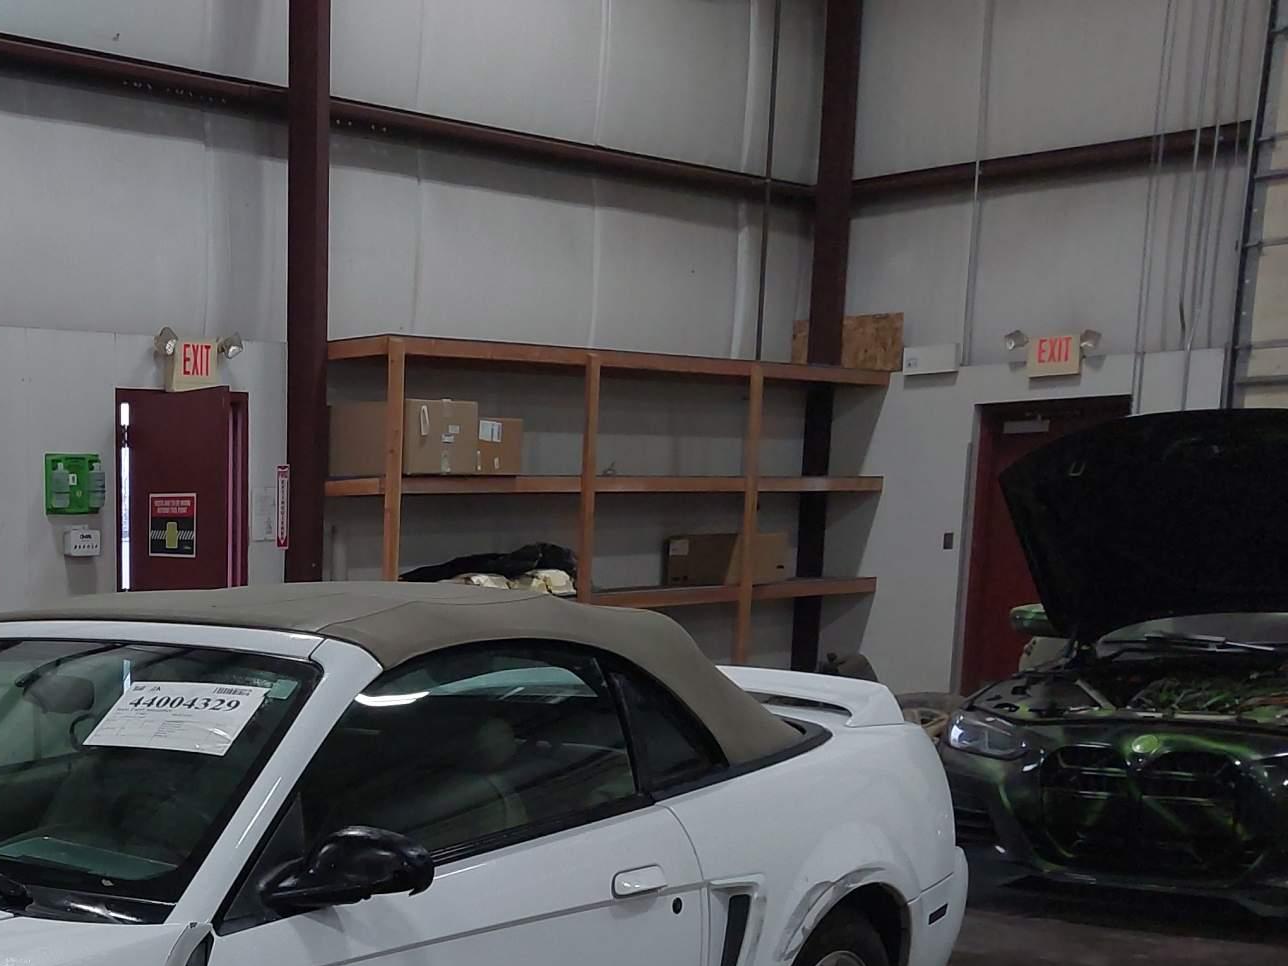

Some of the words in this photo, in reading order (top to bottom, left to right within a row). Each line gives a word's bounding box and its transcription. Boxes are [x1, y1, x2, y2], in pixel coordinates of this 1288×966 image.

[183, 343, 212, 376] EXIT
[1037, 335, 1073, 364] EXIT
[129, 695, 242, 712] 44004329
